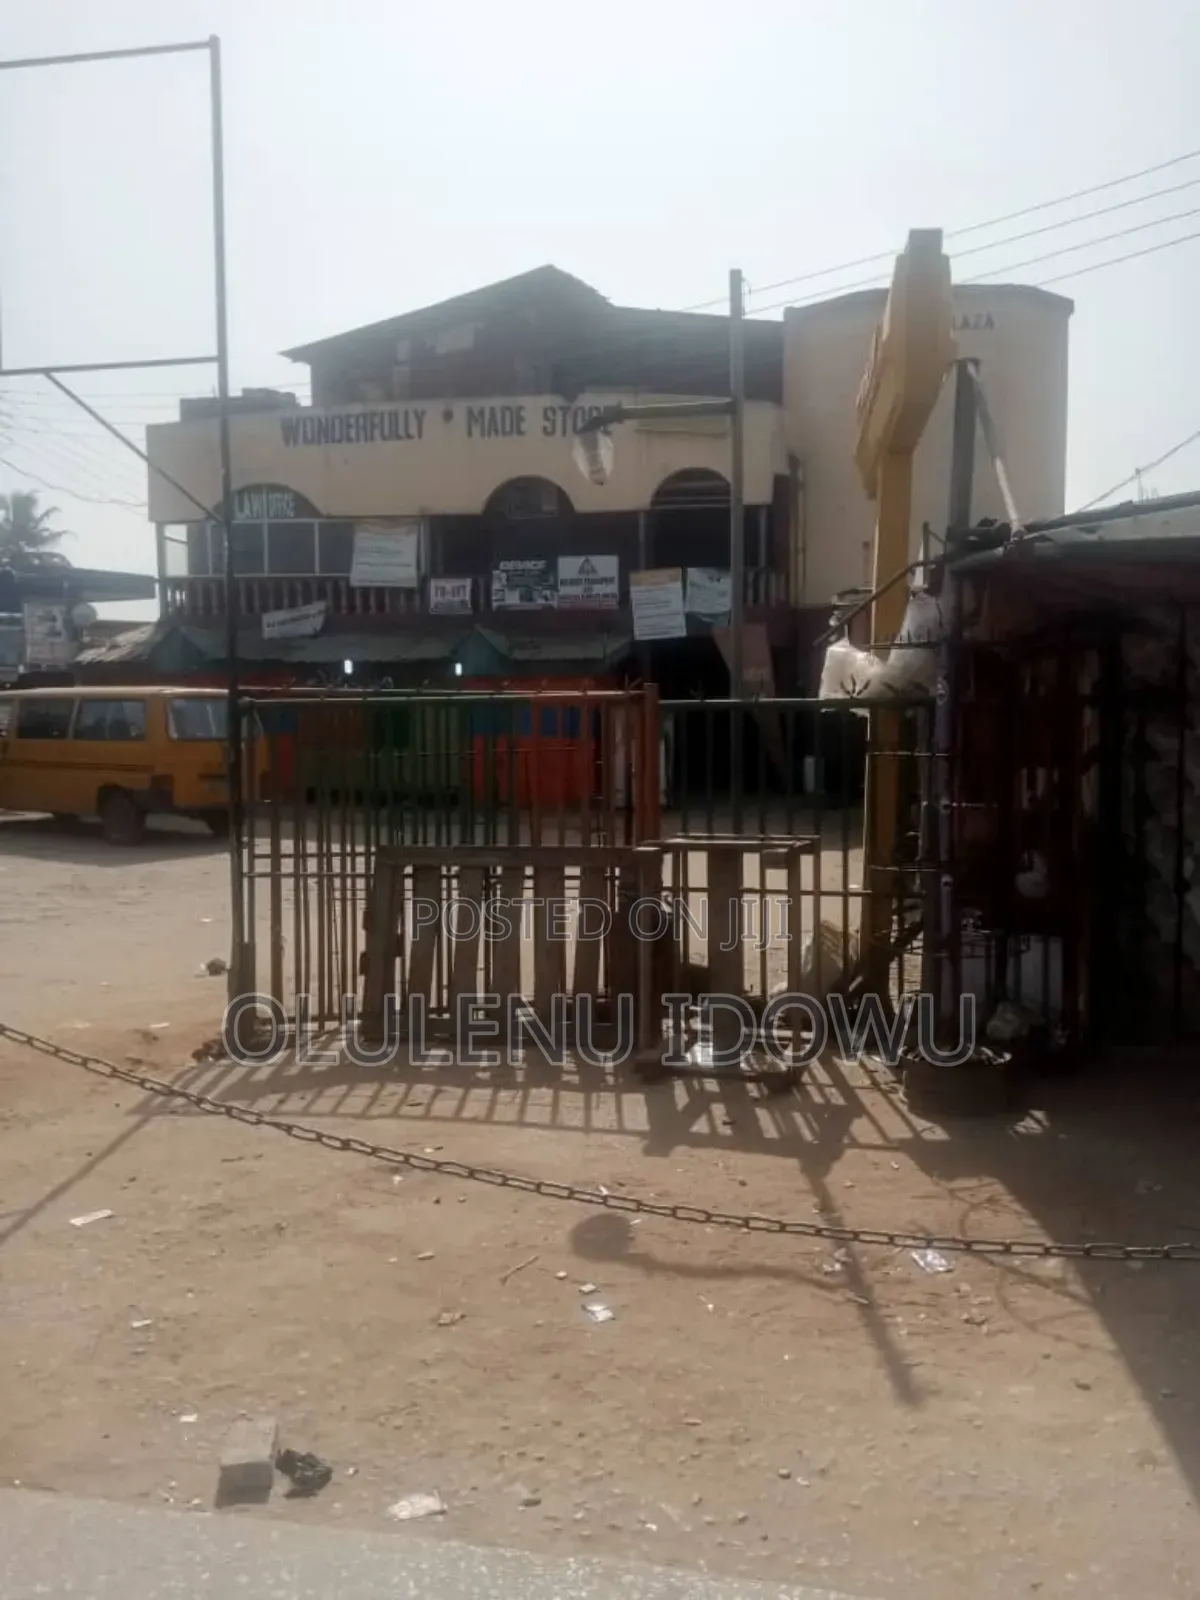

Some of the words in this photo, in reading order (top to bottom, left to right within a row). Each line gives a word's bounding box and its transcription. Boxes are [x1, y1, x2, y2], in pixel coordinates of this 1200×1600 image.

[952, 311, 994, 331] LAZA
[281, 408, 424, 446] WONDERFULLY
[466, 405, 525, 438] MADE
